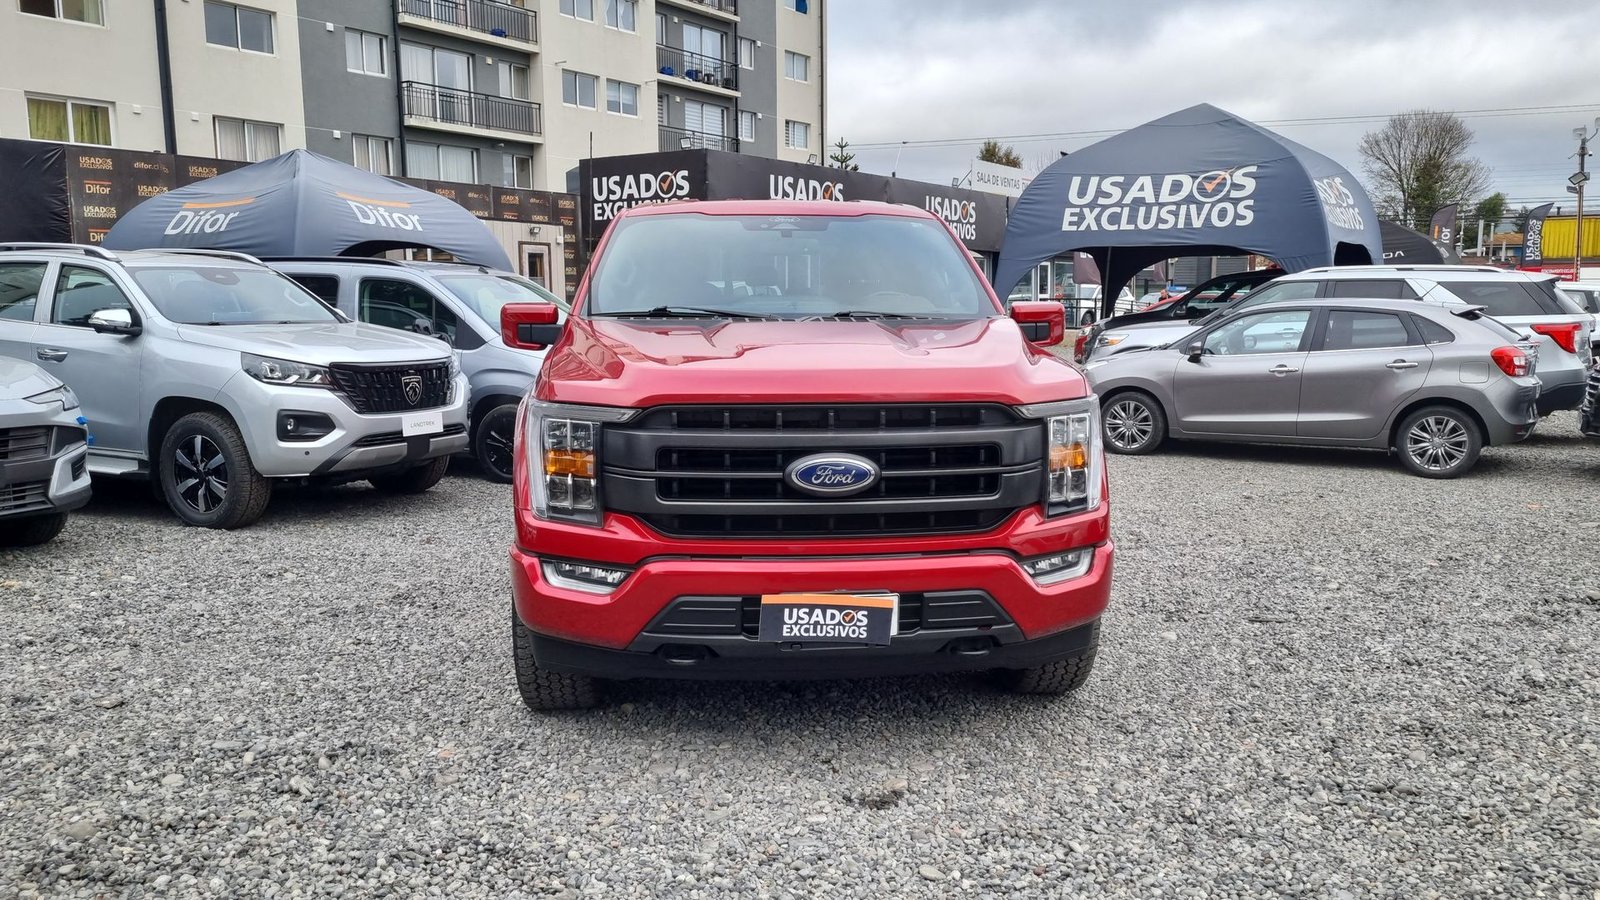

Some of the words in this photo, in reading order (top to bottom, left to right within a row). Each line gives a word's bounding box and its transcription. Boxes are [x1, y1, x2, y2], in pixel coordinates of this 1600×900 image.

[79, 156, 113, 165] USADOS
[188, 166, 218, 174] USADOS
[85, 184, 111, 195] Difor
[137, 185, 169, 193] USADOS
[592, 169, 690, 201] USADOS
[769, 174, 844, 201] USADOS
[976, 171, 990, 184] SALA
[992, 174, 999, 186] DE
[1001, 176, 1020, 190] VENTAS
[1068, 165, 1258, 205] USADOS
[83, 205, 117, 214] USADOS
[346, 199, 423, 232] Difor
[925, 195, 976, 223] USADOS
[1061, 199, 1255, 231] EXCLUSIVOS
[164, 210, 240, 235] Difor
[90, 232, 105, 242] Dif
[1525, 219, 1537, 260] USADOS
[811, 464, 855, 485] Ford
[783, 608, 869, 626] USADOS
[782, 624, 868, 639] EXCLUSIVOS
